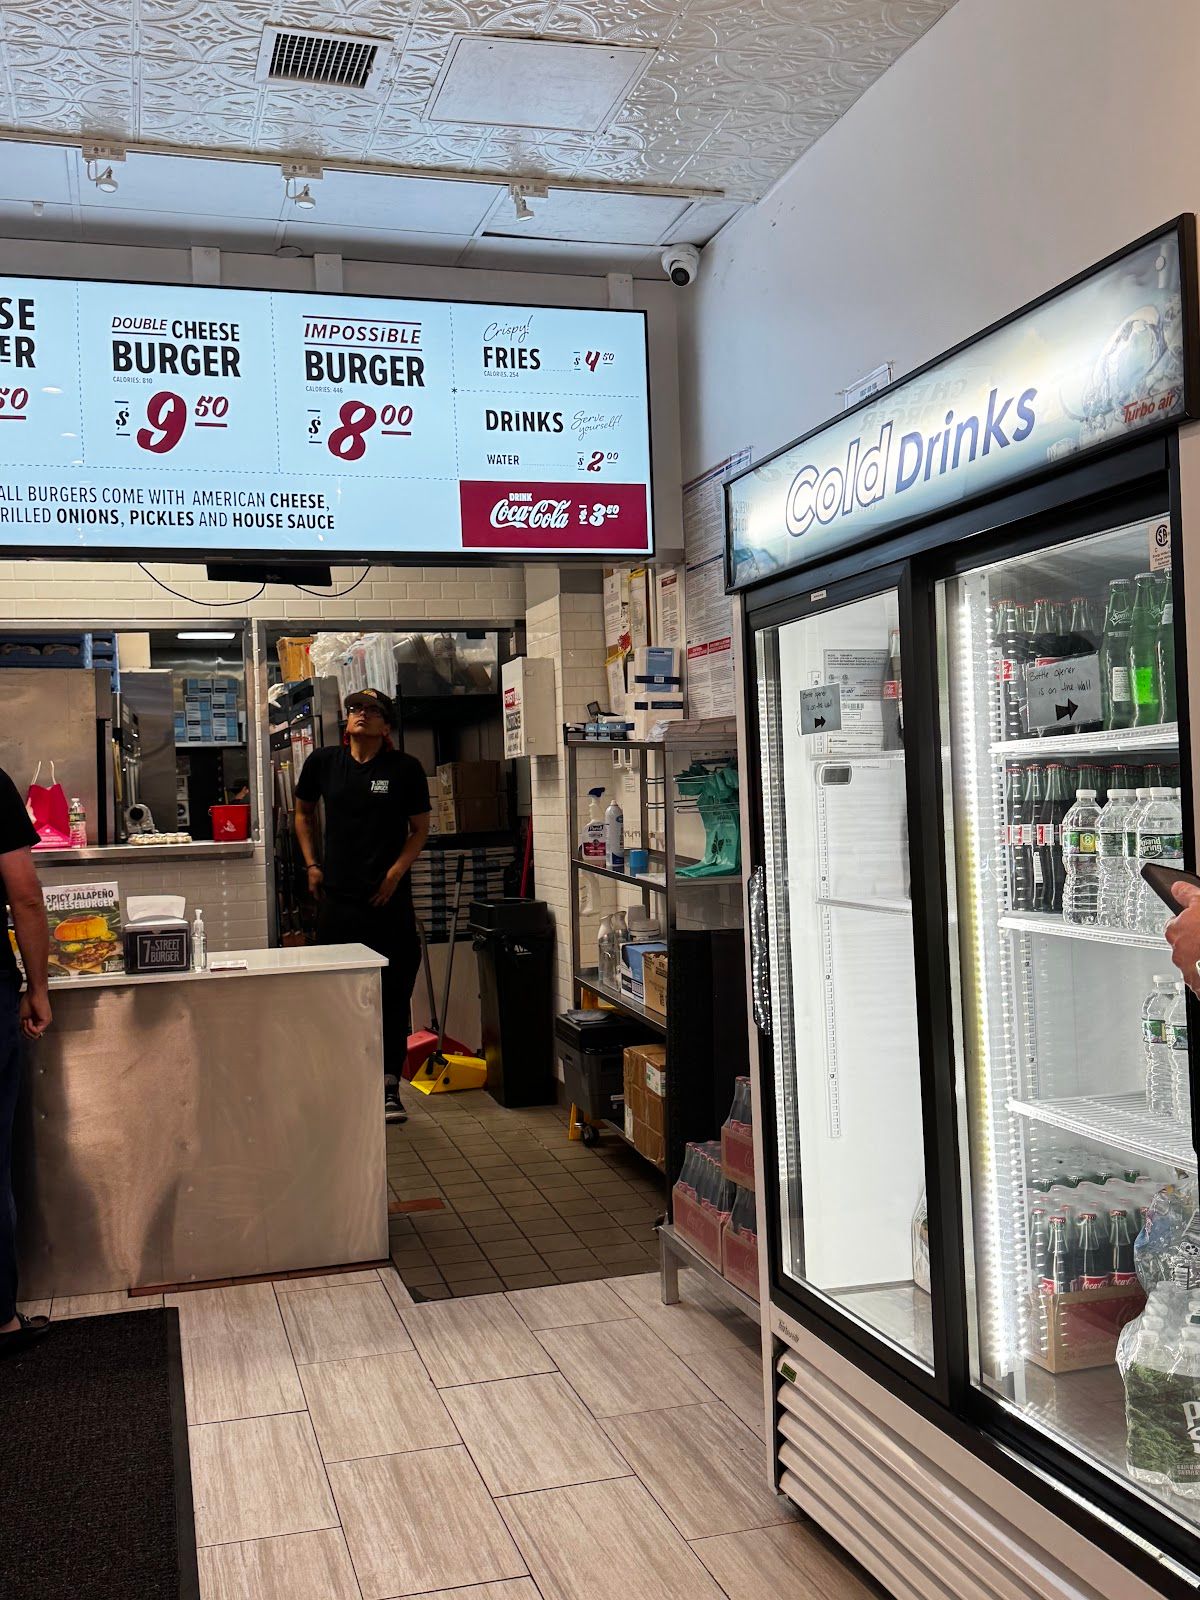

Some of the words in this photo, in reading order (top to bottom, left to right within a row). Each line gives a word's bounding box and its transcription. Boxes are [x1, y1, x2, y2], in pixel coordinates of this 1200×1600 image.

[112, 316, 168, 330] DOUBLE
[171, 320, 240, 342] CHEESE
[483, 314, 534, 344] Crispy!
[112, 340, 241, 378] BURGER
[304, 350, 426, 388] BURGER
[483, 346, 541, 370] FRIES
[570, 410, 604, 431] Serve
[1123, 400, 1156, 424] Turbo
[1158, 392, 1176, 410] air
[136, 390, 187, 454] 9
[328, 400, 376, 461] 8
[486, 454, 520, 466] WATER
[785, 419, 894, 538] Cold
[894, 387, 1039, 495] Drinks
[0, 485, 23, 501] ALL
[28, 486, 97, 503] BURGERS
[102, 488, 144, 504] COME
[148, 488, 184, 505] WITH
[192, 490, 265, 508] AMERICAN
[270, 492, 330, 512] CHEESE,
[508, 492, 532, 502] DRINK
[56, 508, 125, 528] ONIONS,
[130, 510, 194, 526] PICKLES
[198, 512, 228, 528] AND
[232, 512, 284, 528] HOUSE
[287, 514, 336, 530] SAUCE
[490, 498, 572, 528] Coca-Cola
[1038, 688, 1045, 696] is
[1061, 682, 1074, 692] the
[46, 892, 70, 904] SPICY
[72, 888, 114, 901] JALAPEÑO
[46, 898, 115, 912] CHEESEBURGER
[150, 950, 180, 963] BURGER
[154, 938, 180, 950] STREET
